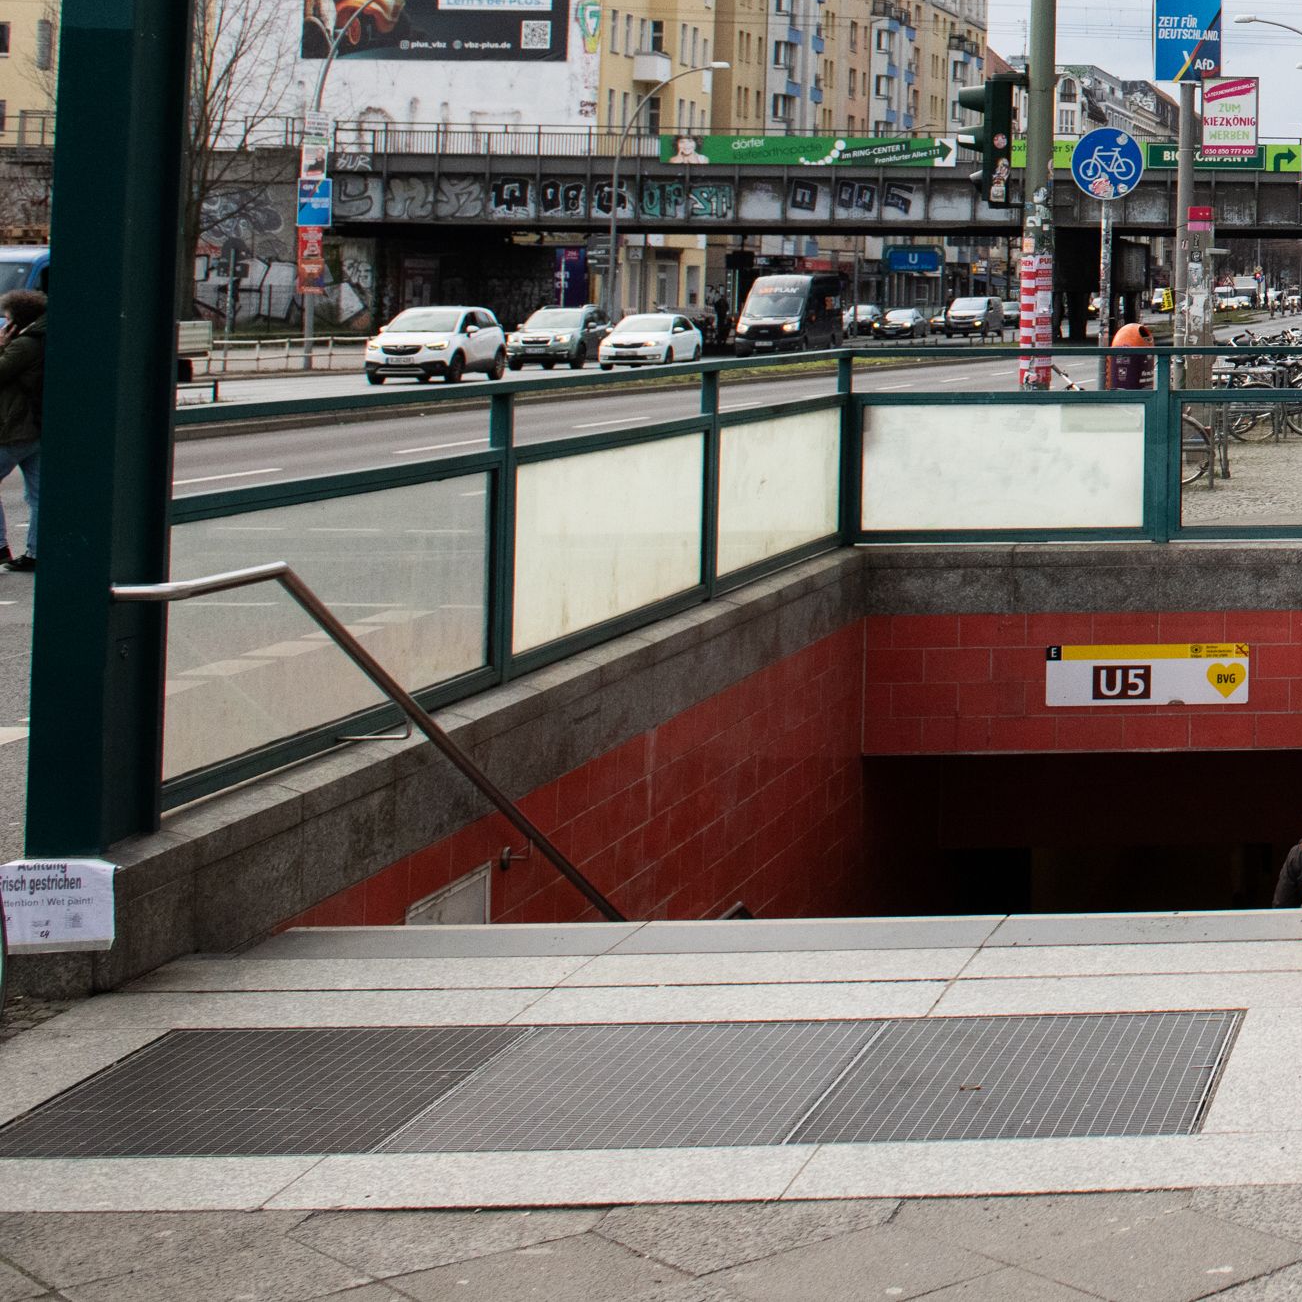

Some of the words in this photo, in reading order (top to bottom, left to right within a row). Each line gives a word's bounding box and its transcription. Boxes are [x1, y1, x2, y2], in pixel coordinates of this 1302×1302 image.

[1158, 16, 1179, 28] ZEIT
[1181, 14, 1198, 28] FÜR
[1158, 28, 1220, 41] DEUTSCHLAND.
[1193, 58, 1215, 71] AfD
[1218, 103, 1241, 114] ZUM
[1203, 114, 1257, 127] KIEZKÖNIG
[1208, 130, 1250, 141] WERBEN
[851, 146, 900, 159] RING-CENTER
[1099, 667, 1146, 697] U5
[1216, 673, 1236, 684] BVG
[29, 875, 81, 895] gestrichen
[47, 898, 65, 906] Wet
